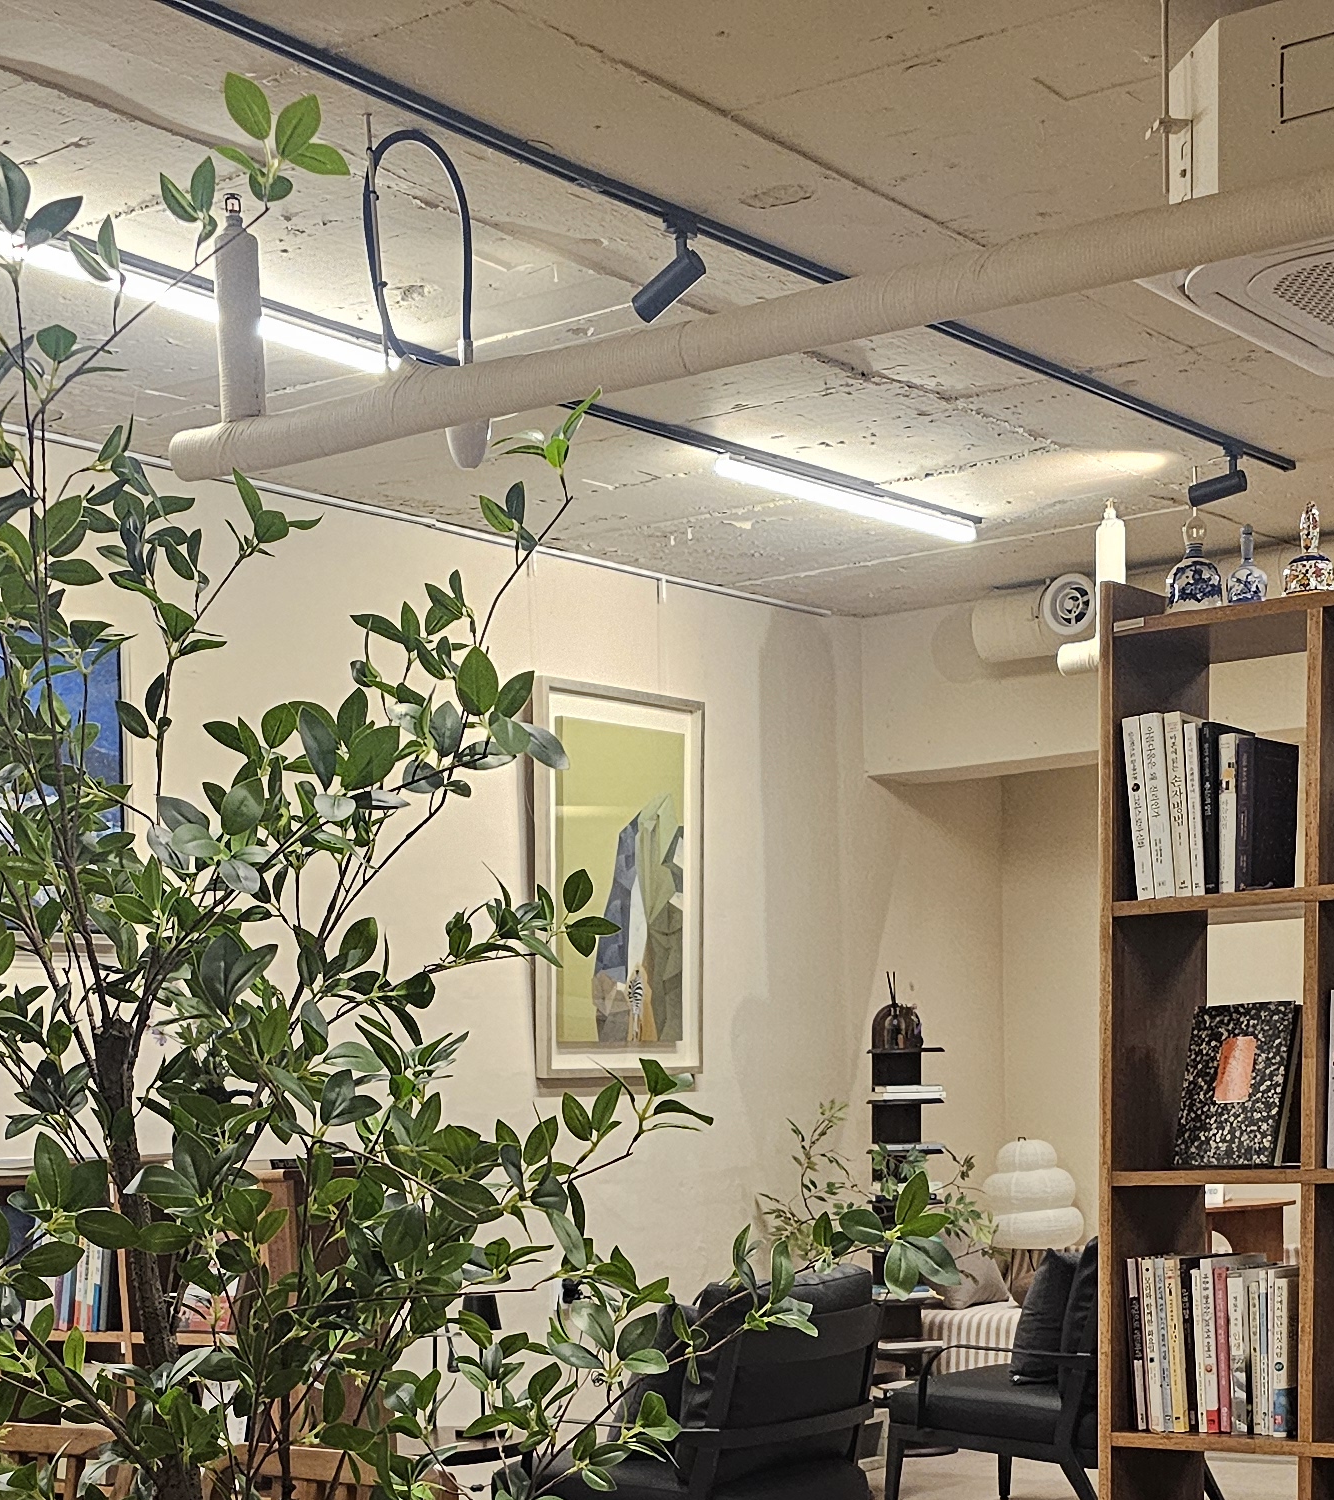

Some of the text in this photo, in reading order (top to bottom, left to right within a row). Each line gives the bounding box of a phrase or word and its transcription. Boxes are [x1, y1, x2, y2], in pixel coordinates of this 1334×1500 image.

[1147, 726, 1161, 818] 아름다움은 왜 진리인가
[1170, 774, 1184, 827] 손자병법
[1136, 834, 1146, 849] 신화
[1144, 1276, 1155, 1353] 모리와 함께한 화요일
